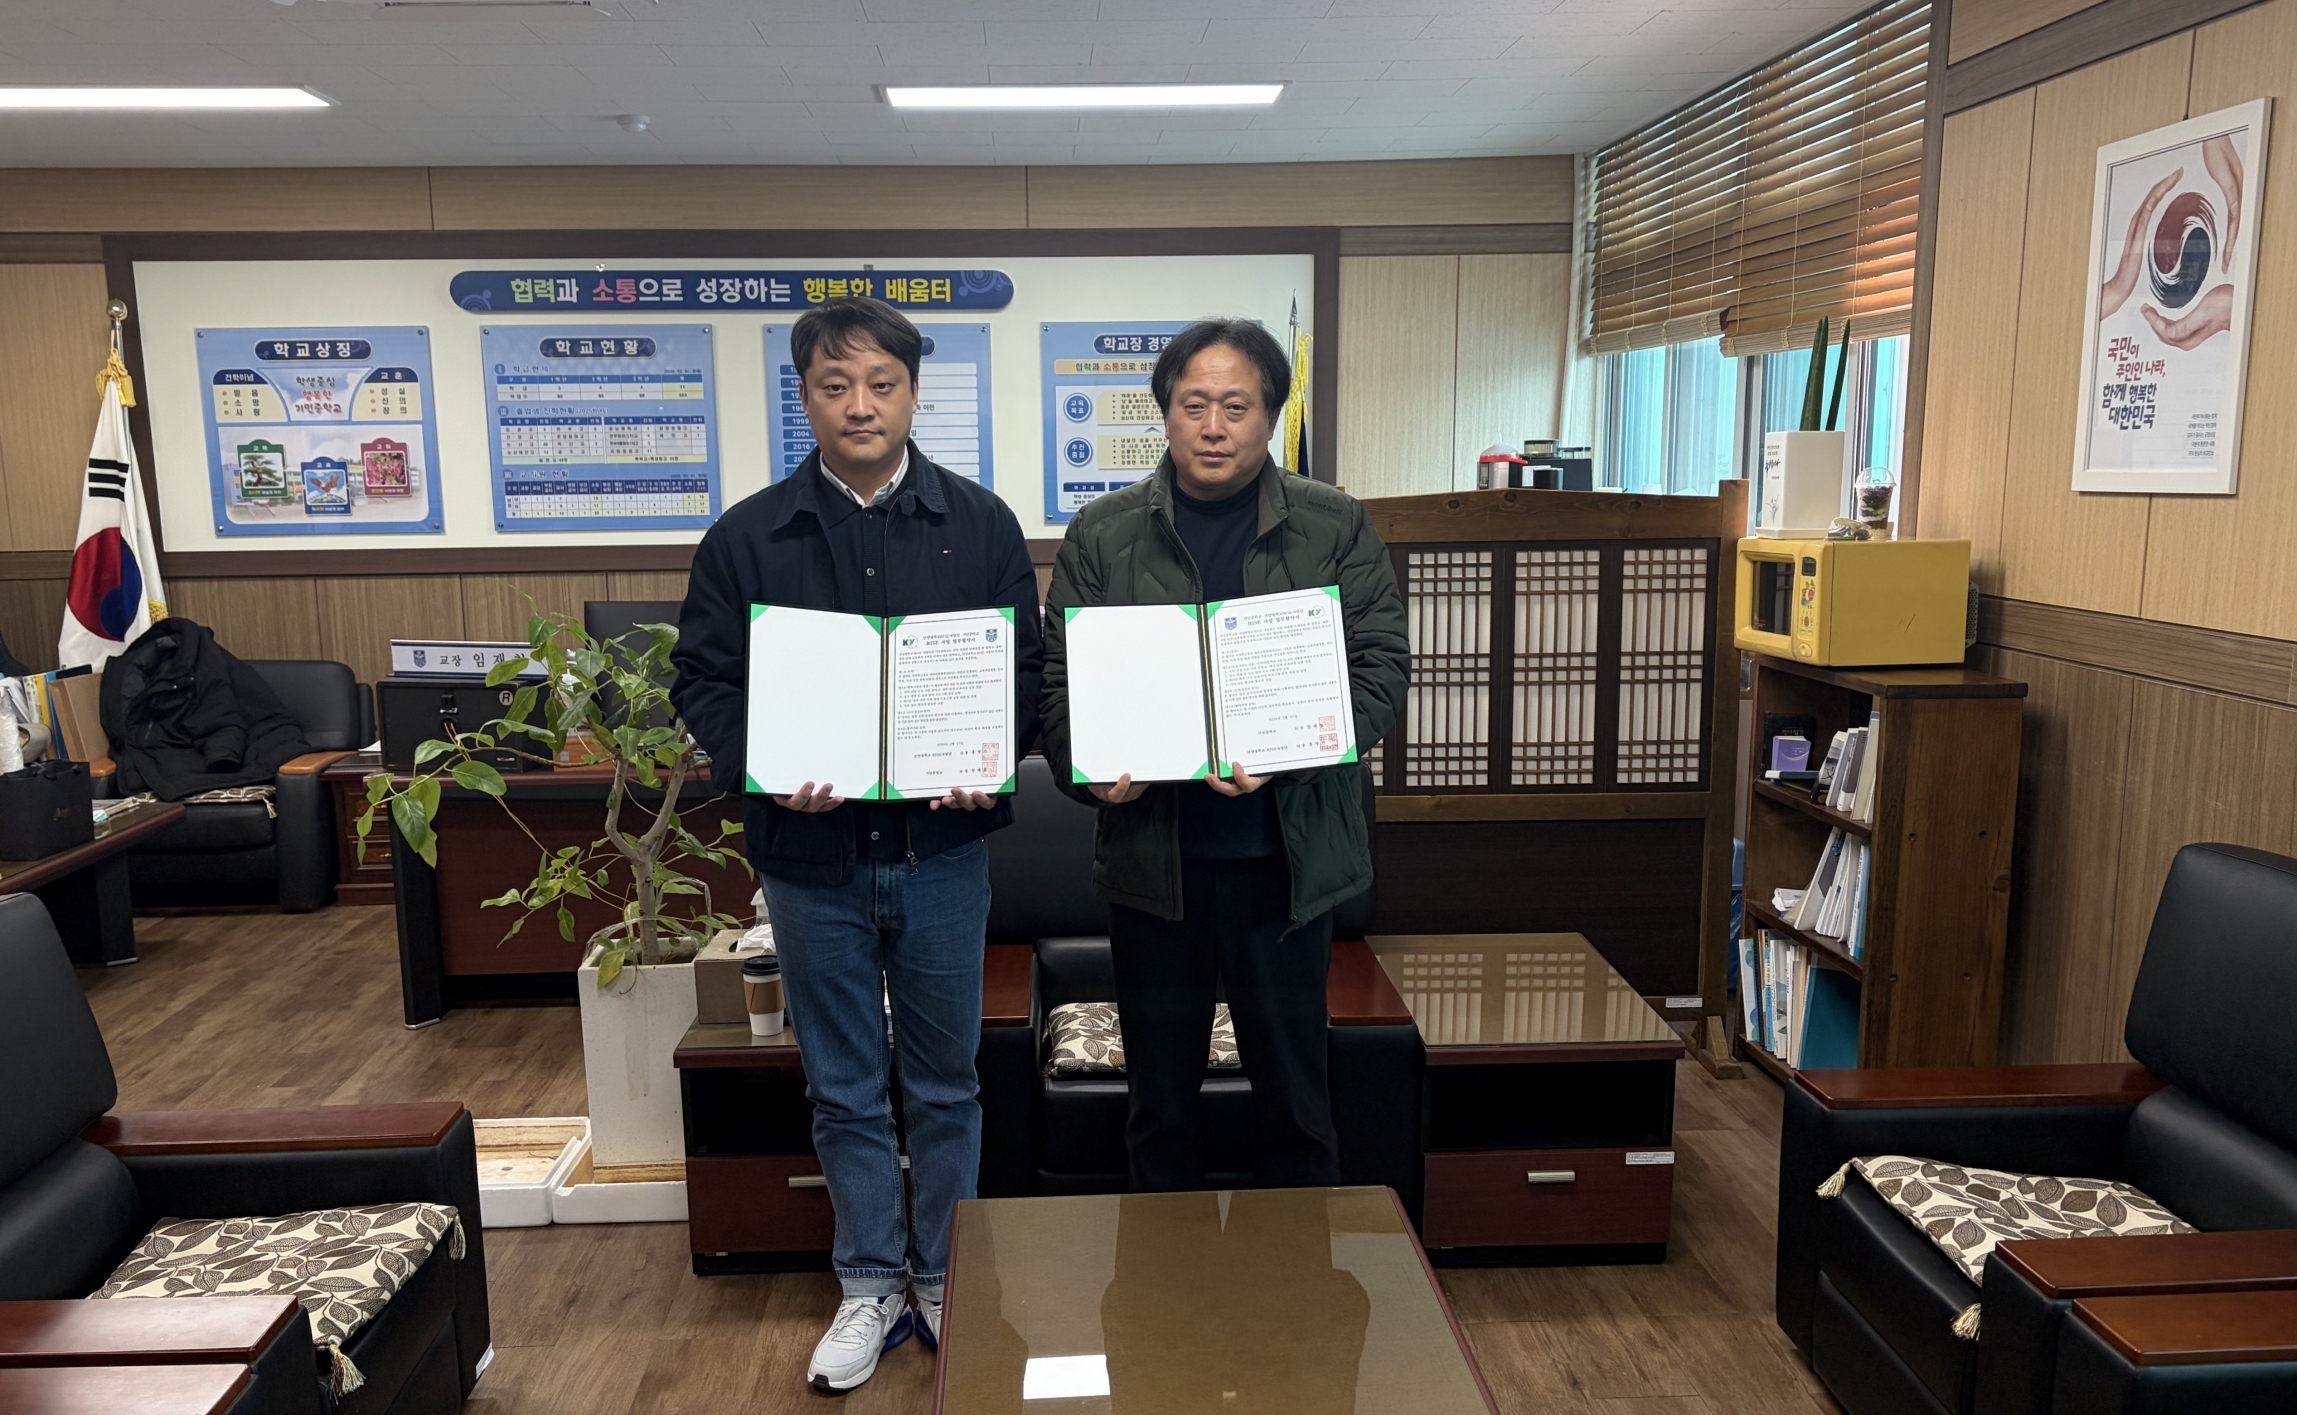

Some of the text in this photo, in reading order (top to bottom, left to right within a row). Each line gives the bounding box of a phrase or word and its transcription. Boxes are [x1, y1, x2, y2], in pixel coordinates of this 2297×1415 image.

[510, 278, 951, 303] 협력과 소통으로 성장하는 행복한 배움터
[273, 342, 351, 358] 학교상징
[555, 340, 639, 355] 학교현황
[1103, 337, 1143, 351] 학교장
[2107, 336, 2140, 362] 국민이
[1075, 362, 1100, 372] 협력과
[1103, 362, 1136, 372] 소통으로
[2116, 359, 2165, 382] 주인인 나라,
[2102, 383, 2157, 408] 함께 행복한
[2108, 405, 2156, 430] 대한민국
[902, 638, 915, 646] KY
[440, 655, 462, 667] 교장
[502, 692, 511, 703] R
